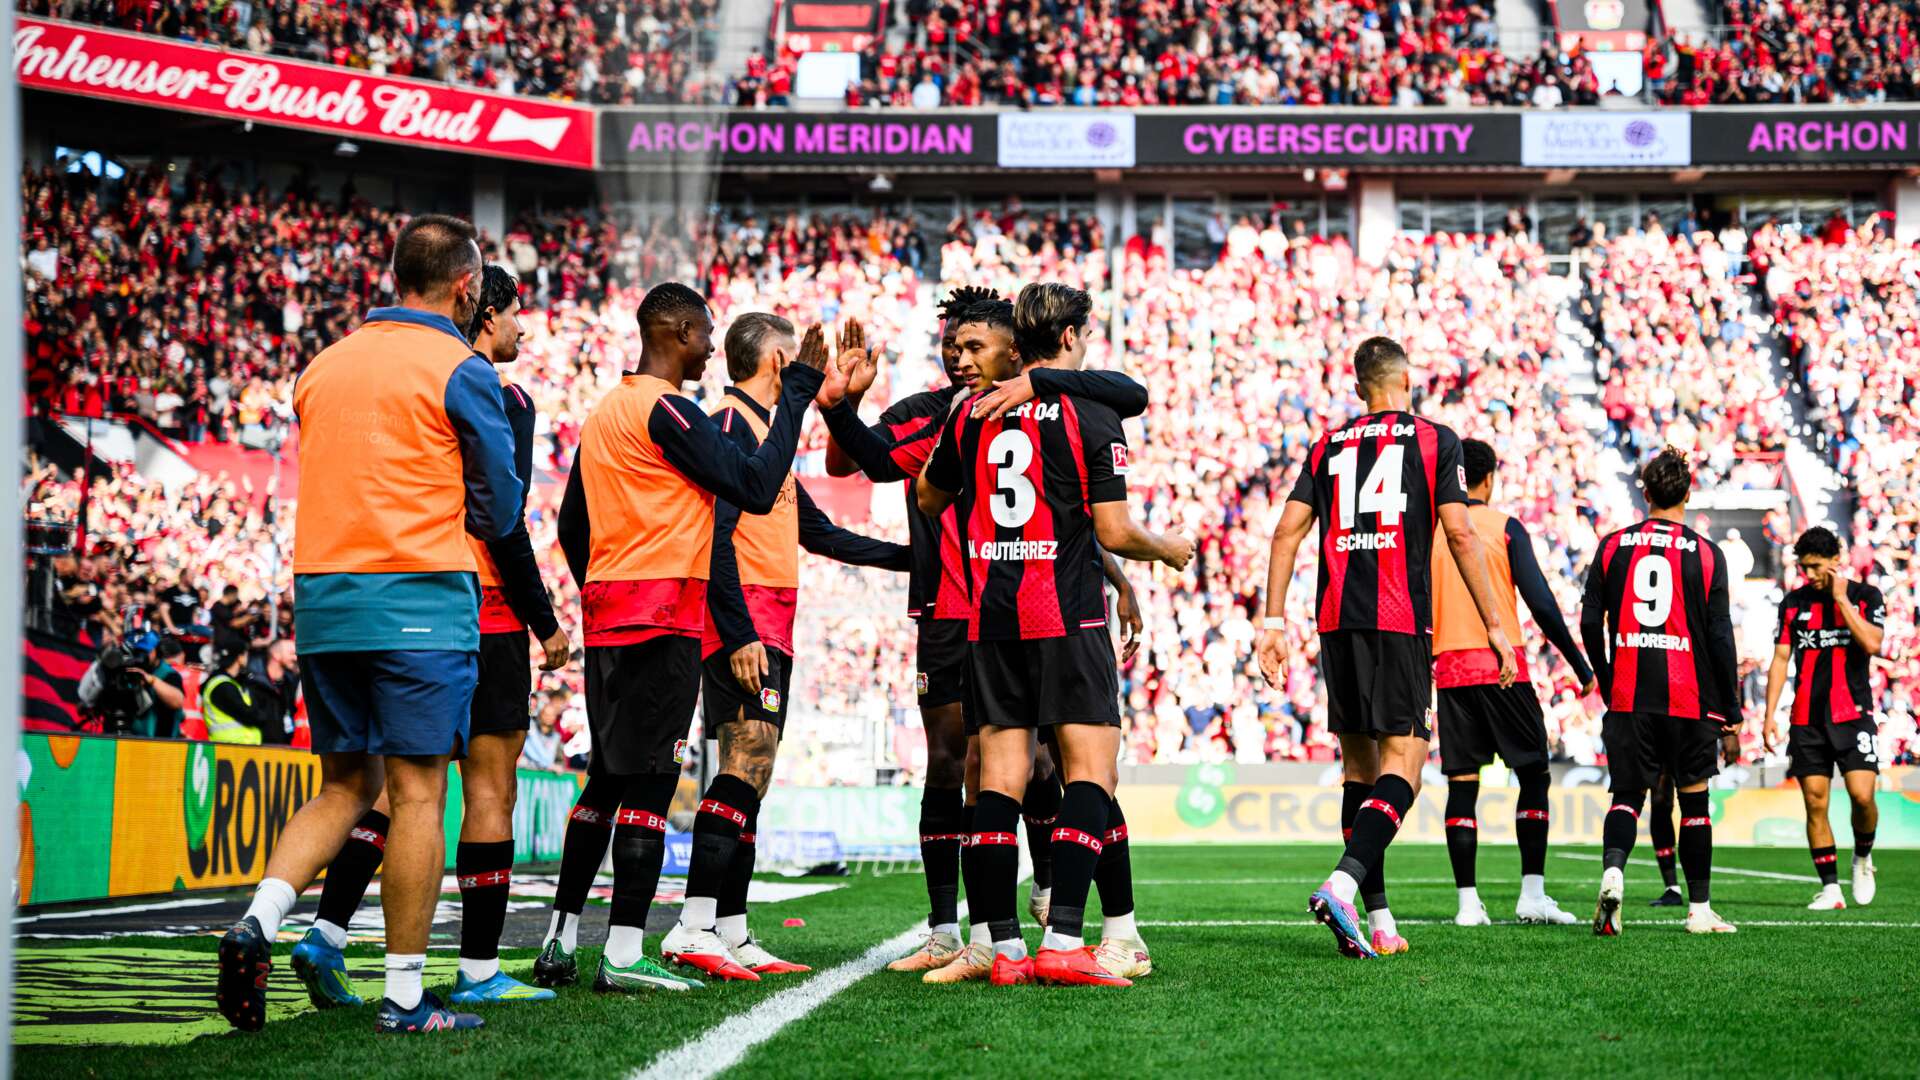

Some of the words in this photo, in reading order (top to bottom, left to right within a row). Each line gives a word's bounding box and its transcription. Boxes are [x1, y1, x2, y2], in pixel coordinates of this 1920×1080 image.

[372, 84, 486, 143] Bud
[628, 122, 784, 153] ARCHON
[794, 123, 973, 153] MERIDIAN
[1183, 123, 1474, 154] CYBERSECURITY
[1747, 120, 1907, 152] ARCHON
[1034, 402, 1059, 421] 04
[1331, 424, 1387, 443] BAYER
[1391, 424, 1415, 437] 04
[987, 429, 1036, 528] 3
[1328, 444, 1407, 530] 14
[980, 537, 1058, 560] GUTIÉRREZ
[1336, 532, 1397, 552] SCHICK
[1620, 533, 1673, 548] BAYER
[1675, 536, 1697, 552] 04
[1632, 554, 1673, 628] 9
[1627, 633, 1690, 652] MOREIRA
[1226, 792, 1448, 834] CRON
